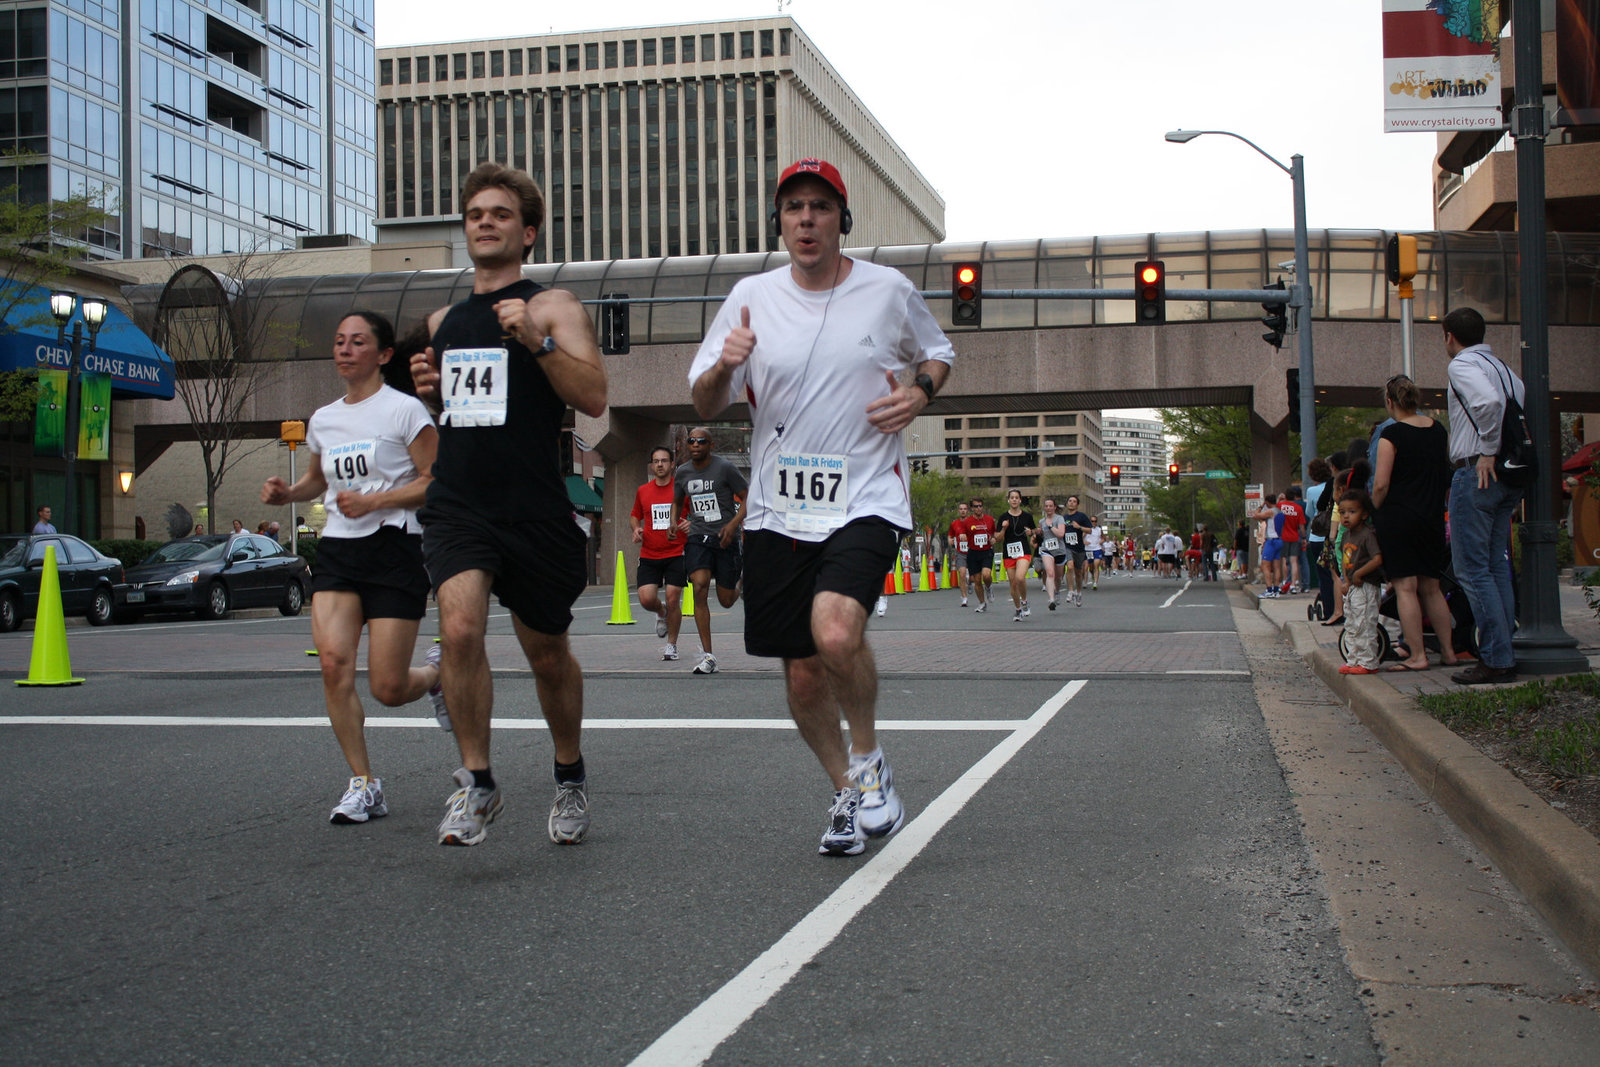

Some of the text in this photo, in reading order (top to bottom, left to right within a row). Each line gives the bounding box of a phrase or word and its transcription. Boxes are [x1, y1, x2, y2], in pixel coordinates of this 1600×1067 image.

[1391, 116, 1496, 128] www.crystalcity.org
[35, 344, 160, 382] CHEV CHASE BANK
[451, 366, 493, 396] 744
[334, 453, 369, 480] 190
[778, 454, 843, 470] Crystal Run 5K Fridays
[778, 468, 843, 503] 1167
[694, 499, 716, 511] 1257
